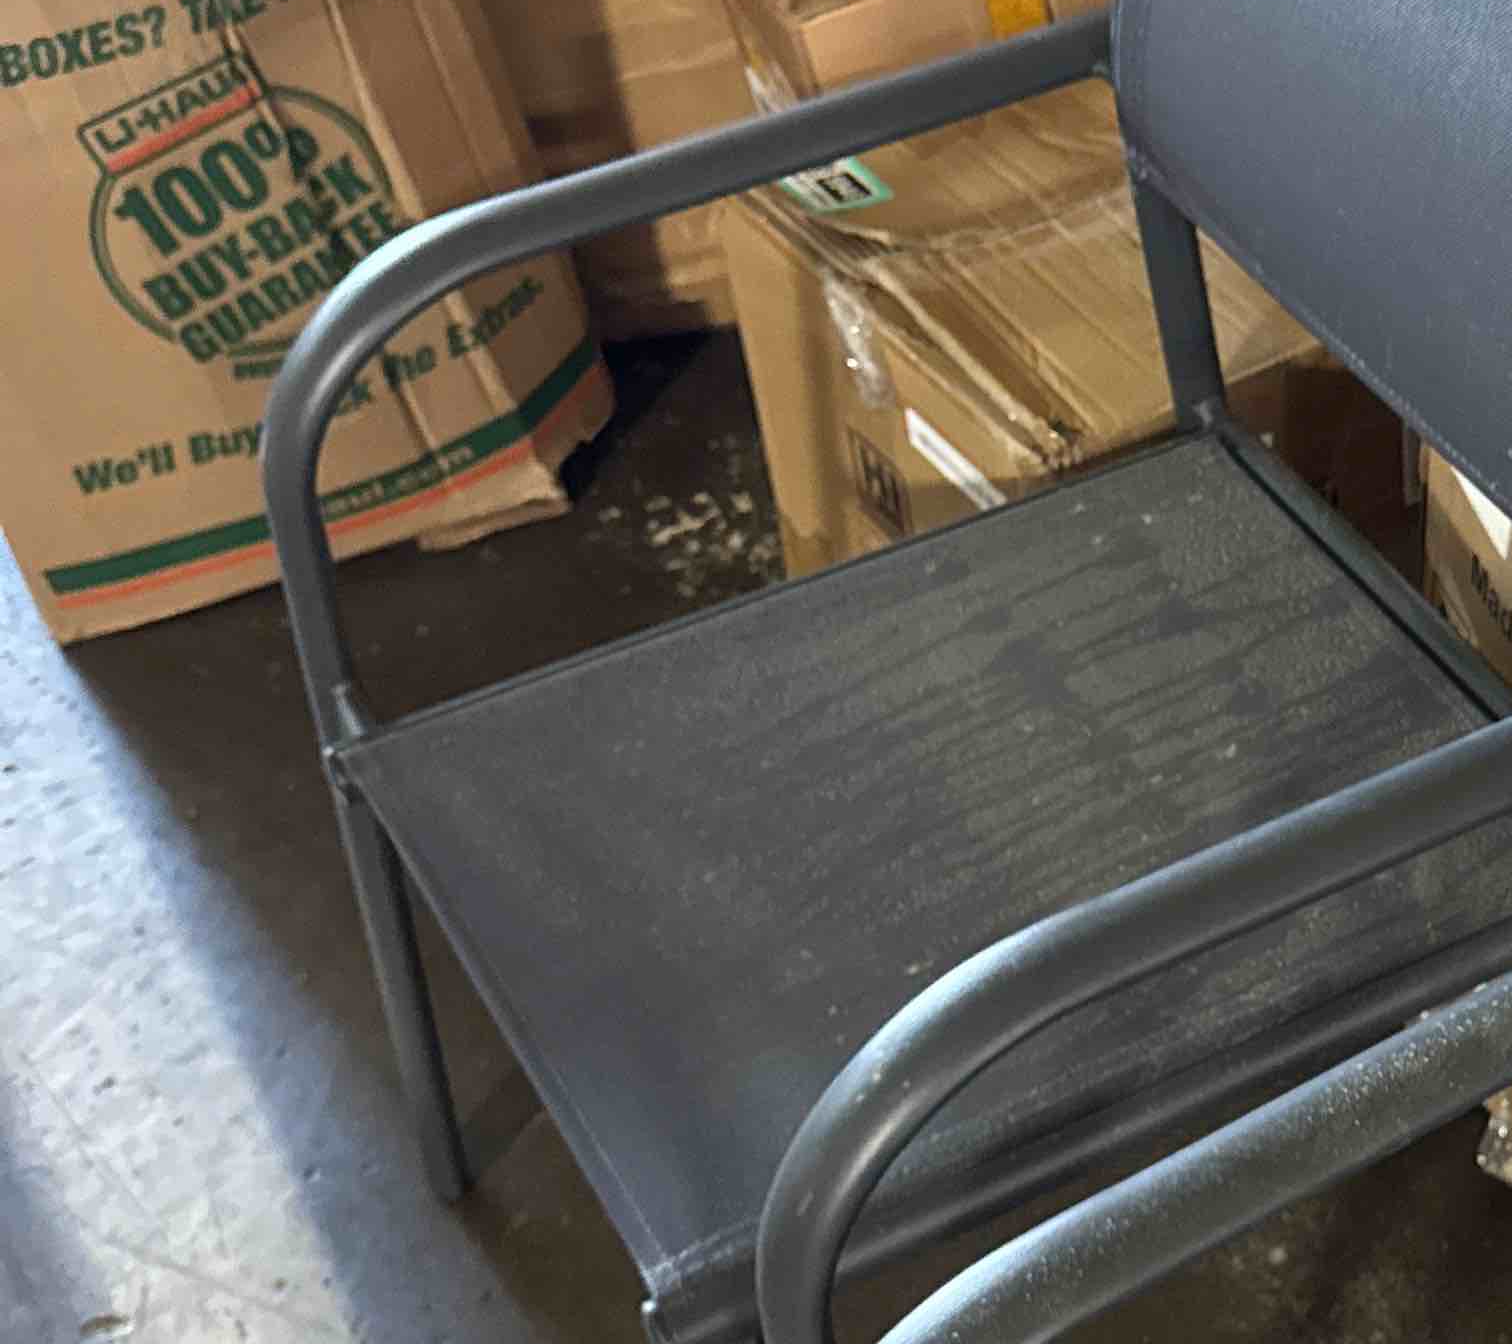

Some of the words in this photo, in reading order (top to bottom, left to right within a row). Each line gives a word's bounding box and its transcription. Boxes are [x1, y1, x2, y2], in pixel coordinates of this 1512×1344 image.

[0, 4, 166, 88] BOXES?
[113, 119, 319, 254] 100%
[73, 440, 176, 495] We'll
